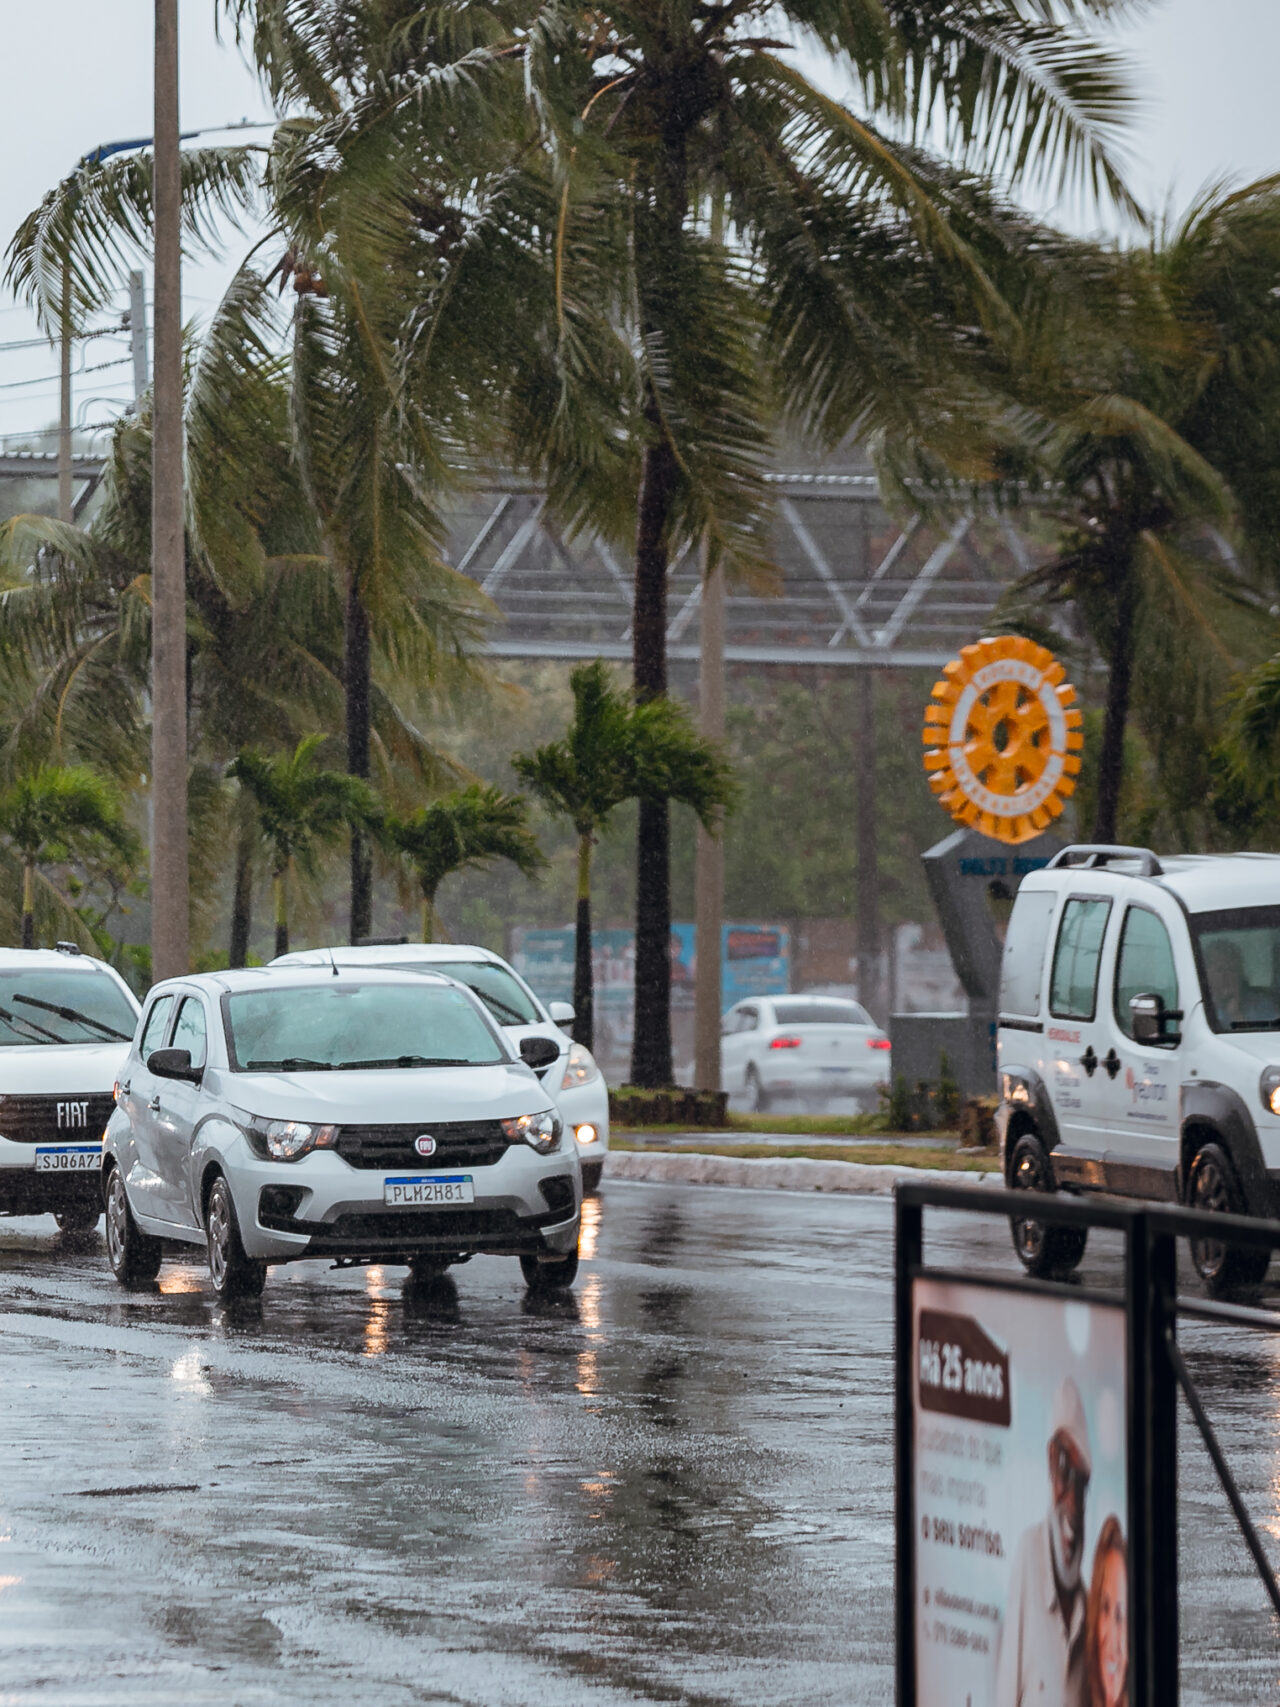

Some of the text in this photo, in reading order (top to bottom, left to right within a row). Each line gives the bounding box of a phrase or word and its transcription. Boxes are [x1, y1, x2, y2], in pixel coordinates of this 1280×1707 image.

[57, 1102, 89, 1128] FIAT
[43, 1154, 102, 1169] SJQ6A71
[393, 1184, 464, 1202] PLM2H81
[942, 1342, 963, 1391] 25
[964, 1358, 1004, 1400] anos
[921, 1515, 930, 1539] o
[932, 1517, 954, 1548] seu
